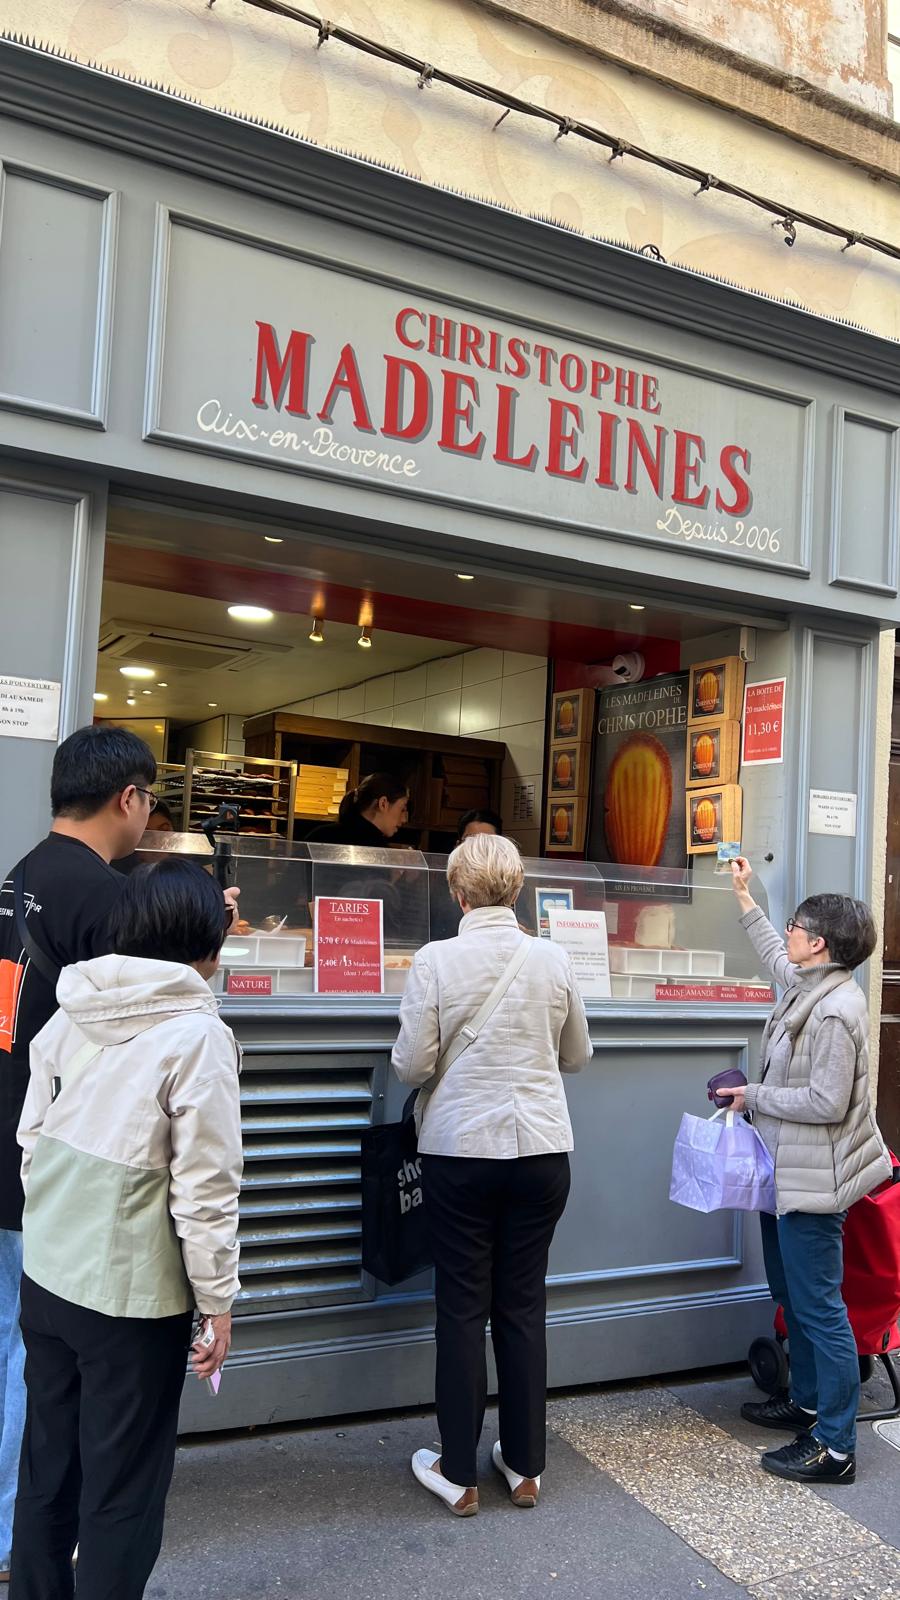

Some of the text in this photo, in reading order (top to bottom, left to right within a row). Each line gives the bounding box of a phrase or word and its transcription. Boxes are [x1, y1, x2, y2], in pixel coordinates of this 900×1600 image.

[395, 307, 662, 416] CHRISTOPHE
[251, 320, 754, 518] MADELEINES
[656, 506, 783, 553] Depuis 2006
[597, 705, 687, 735] CHRISTOPHE
[748, 722, 772, 736] 11,30
[329, 901, 370, 915] TARIFS
[556, 919, 600, 929] INFORMATION
[231, 980, 270, 989] NATURE
[684, 988, 715, 997] AMANDE
[744, 990, 773, 999] ORANGE
